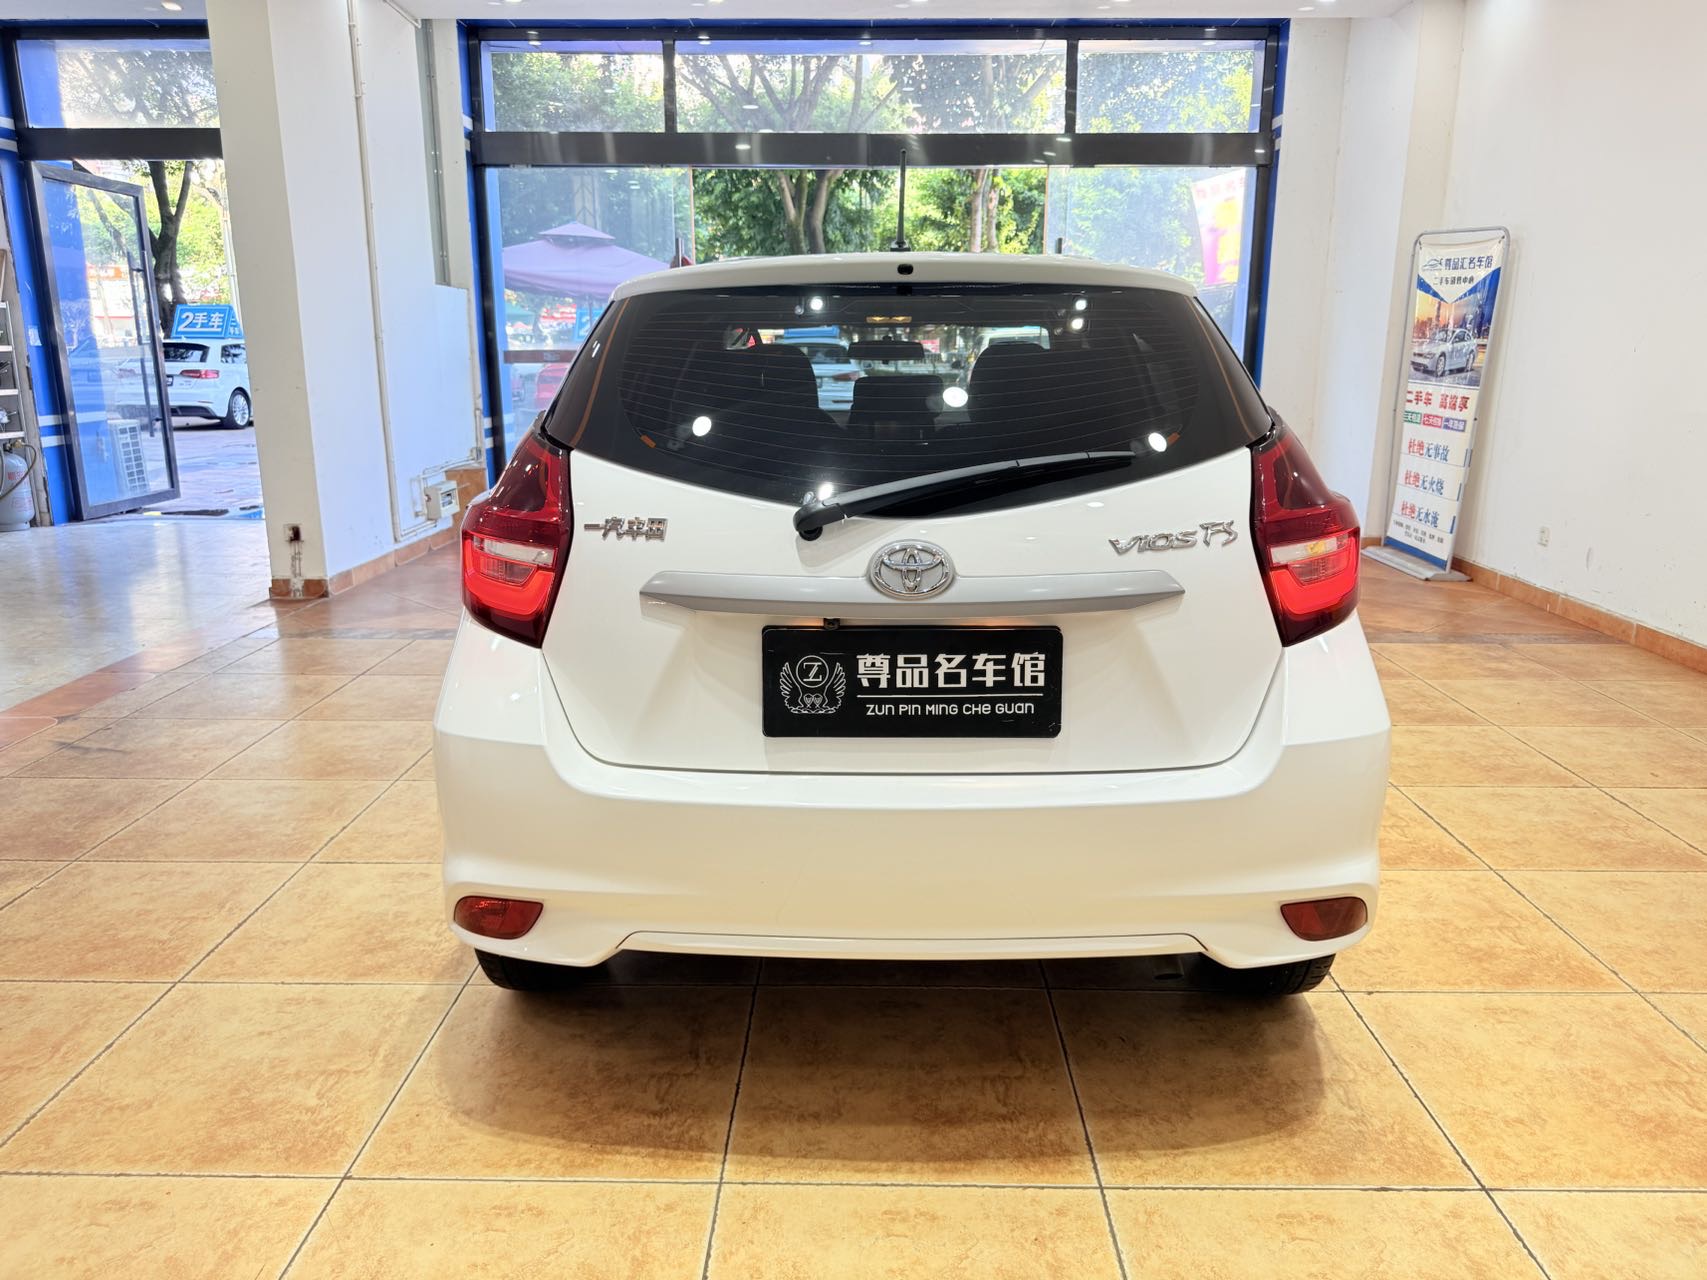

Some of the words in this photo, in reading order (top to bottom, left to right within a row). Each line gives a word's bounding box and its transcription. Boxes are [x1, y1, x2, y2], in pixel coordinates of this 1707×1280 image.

[177, 311, 225, 332] 2手车
[1406, 390, 1432, 407] 二手车
[1407, 438, 1450, 462] 杜绝无事故
[1404, 470, 1445, 496] 杜绝无火烧
[1108, 530, 1198, 555] VIOS
[1199, 519, 1239, 547] FS
[856, 651, 1046, 688] 尊品名车馆
